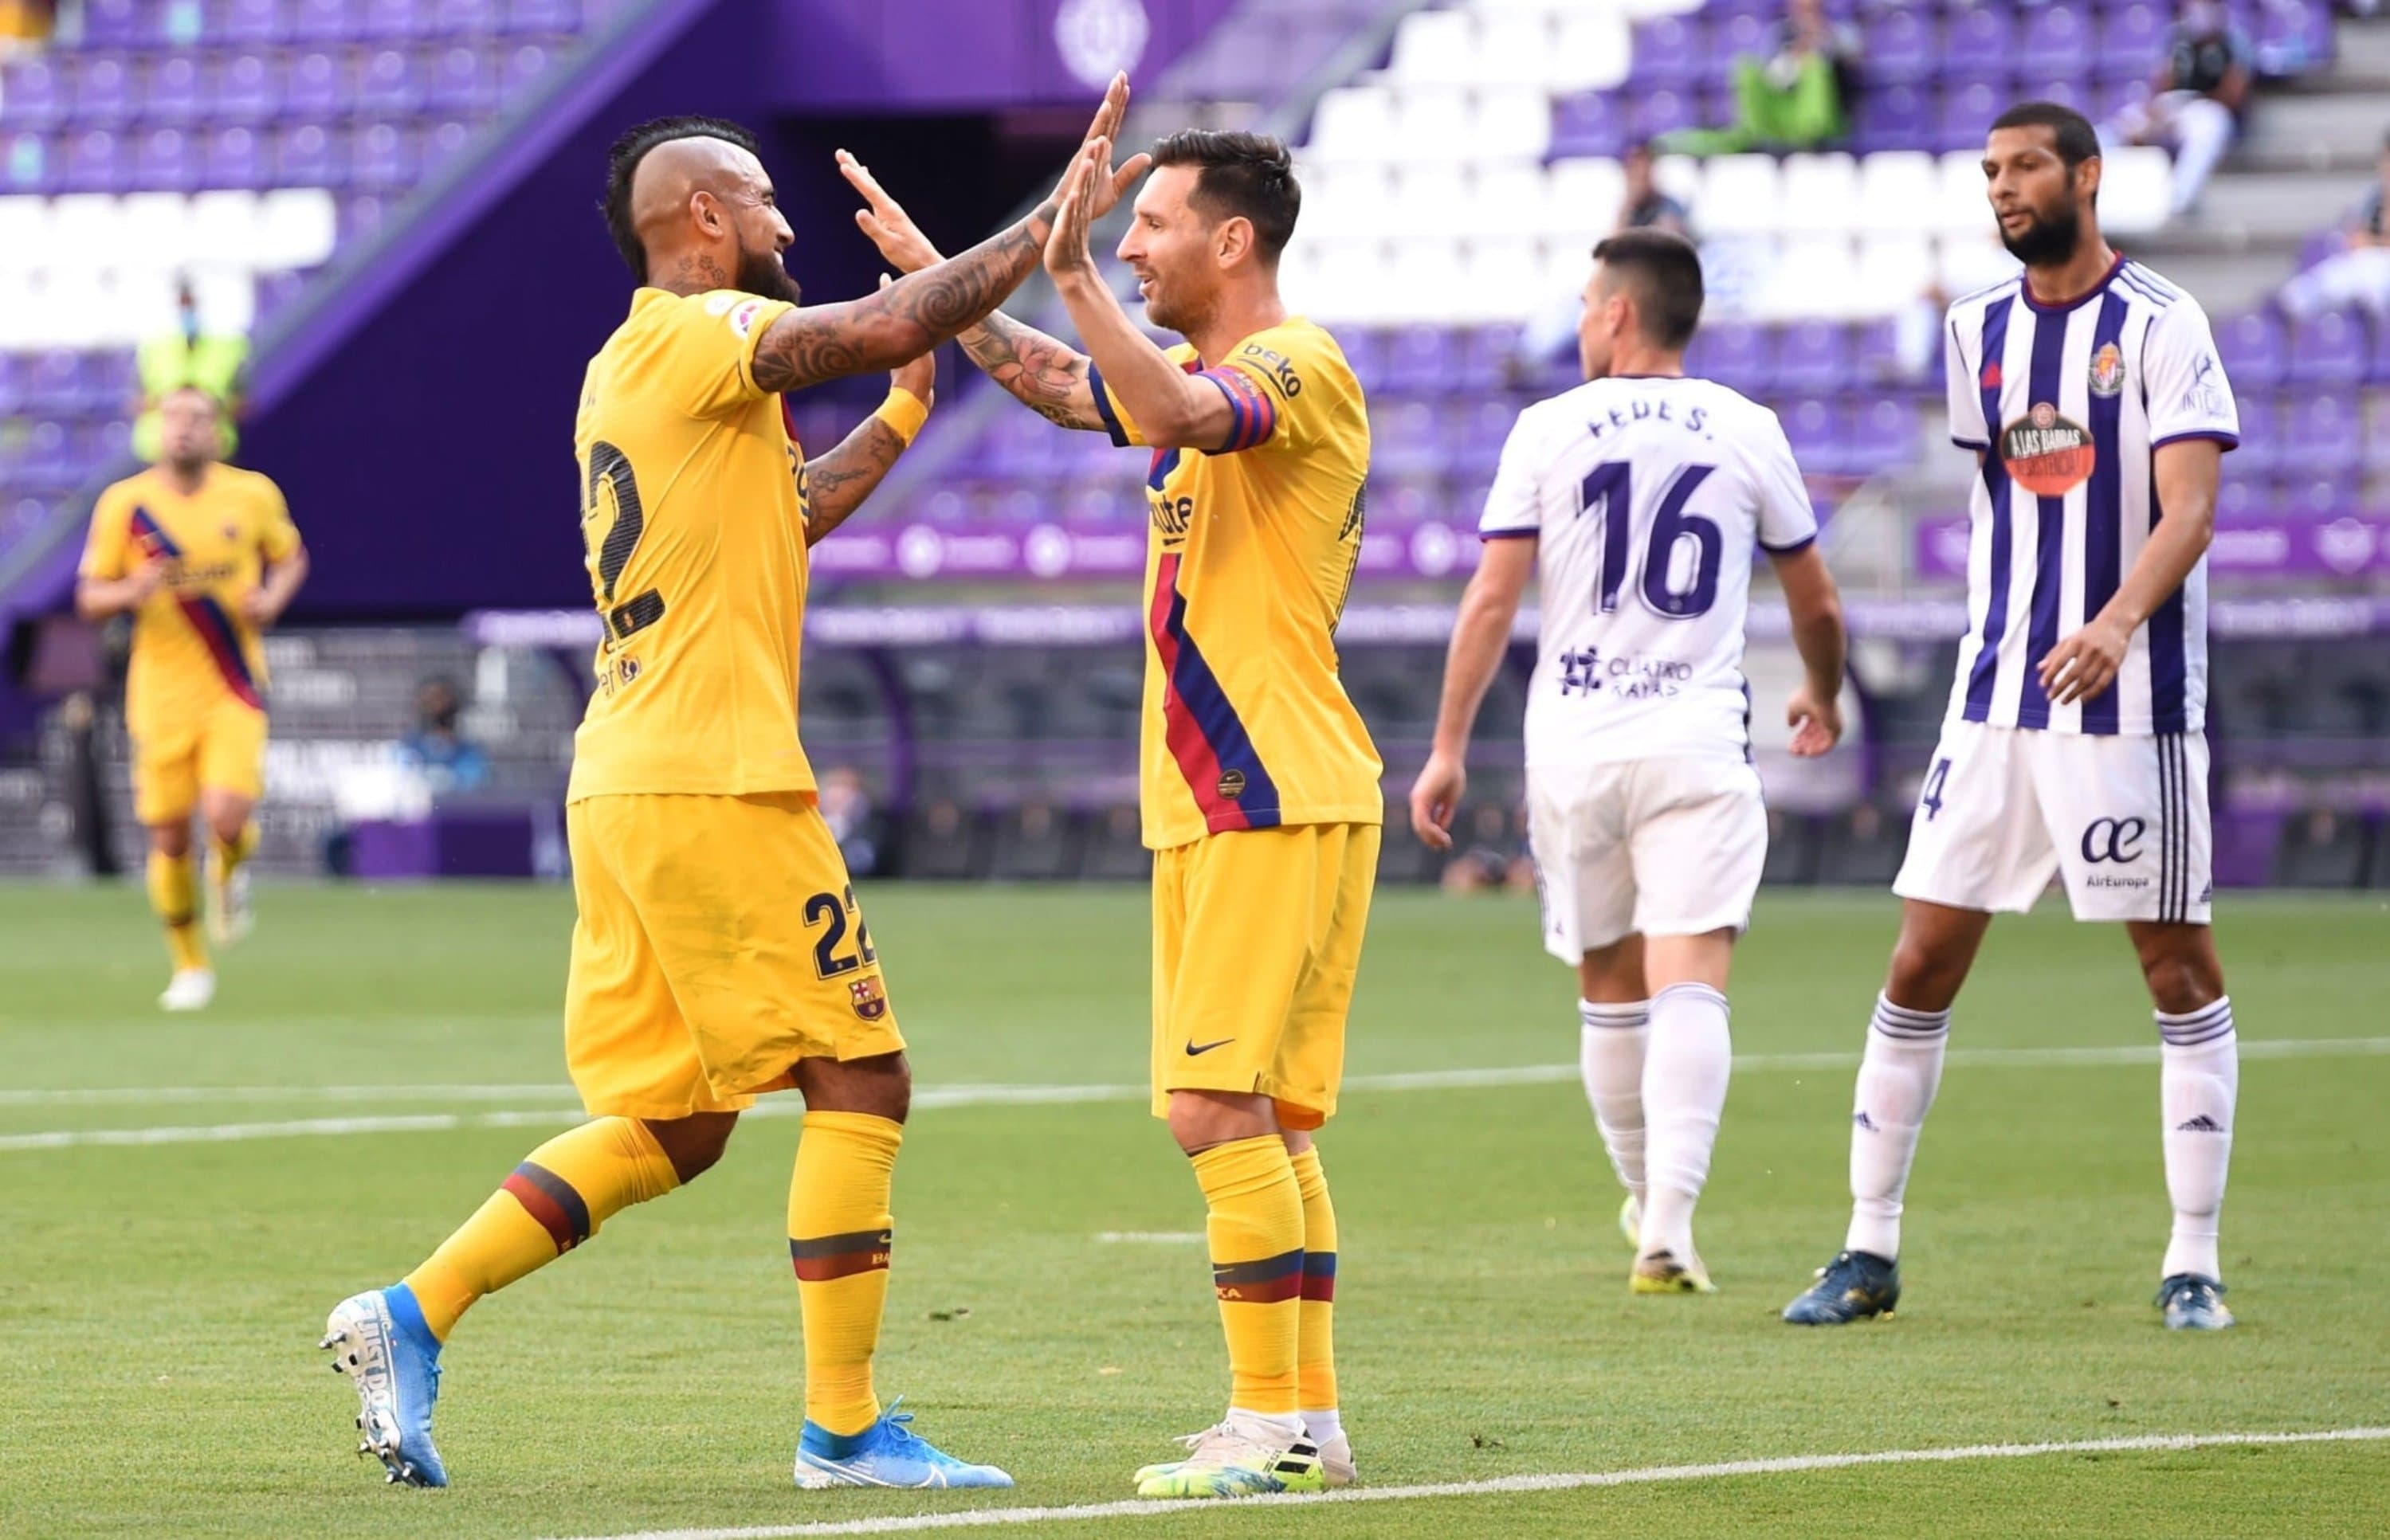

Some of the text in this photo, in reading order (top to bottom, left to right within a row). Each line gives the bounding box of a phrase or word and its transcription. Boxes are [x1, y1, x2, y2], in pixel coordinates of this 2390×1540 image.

[1242, 343, 1302, 398] beko
[1575, 460, 1724, 621] 16
[1922, 758, 1952, 821] 4
[2086, 876, 2149, 889] AirEuropa
